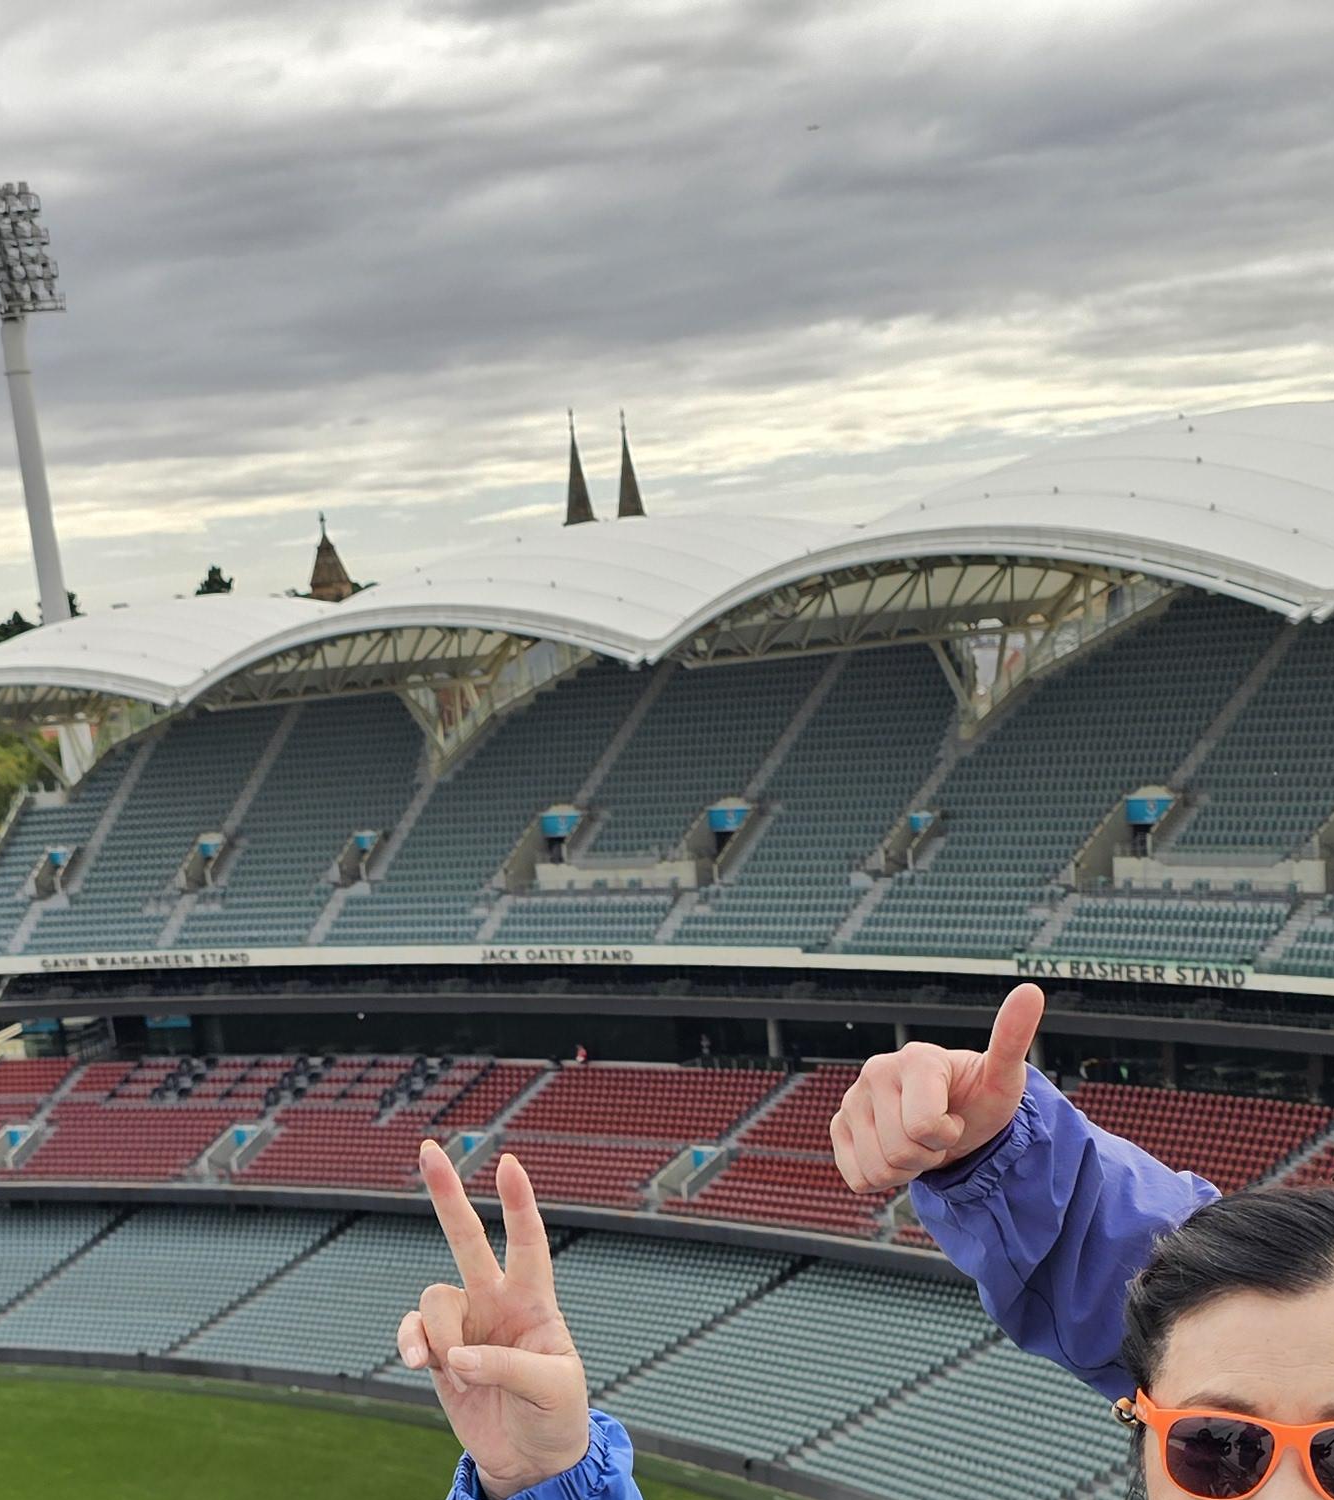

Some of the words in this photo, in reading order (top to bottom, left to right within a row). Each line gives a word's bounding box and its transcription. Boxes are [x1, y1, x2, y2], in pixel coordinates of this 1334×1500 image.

[41, 957, 89, 970] GAVIN
[200, 952, 250, 965] STAND
[482, 949, 518, 961] JACK
[525, 949, 576, 961] OATEY
[582, 949, 634, 962] STAND
[1017, 960, 1061, 976] MAX
[1069, 961, 1167, 982] BASHEER
[1175, 966, 1246, 987] STAND
